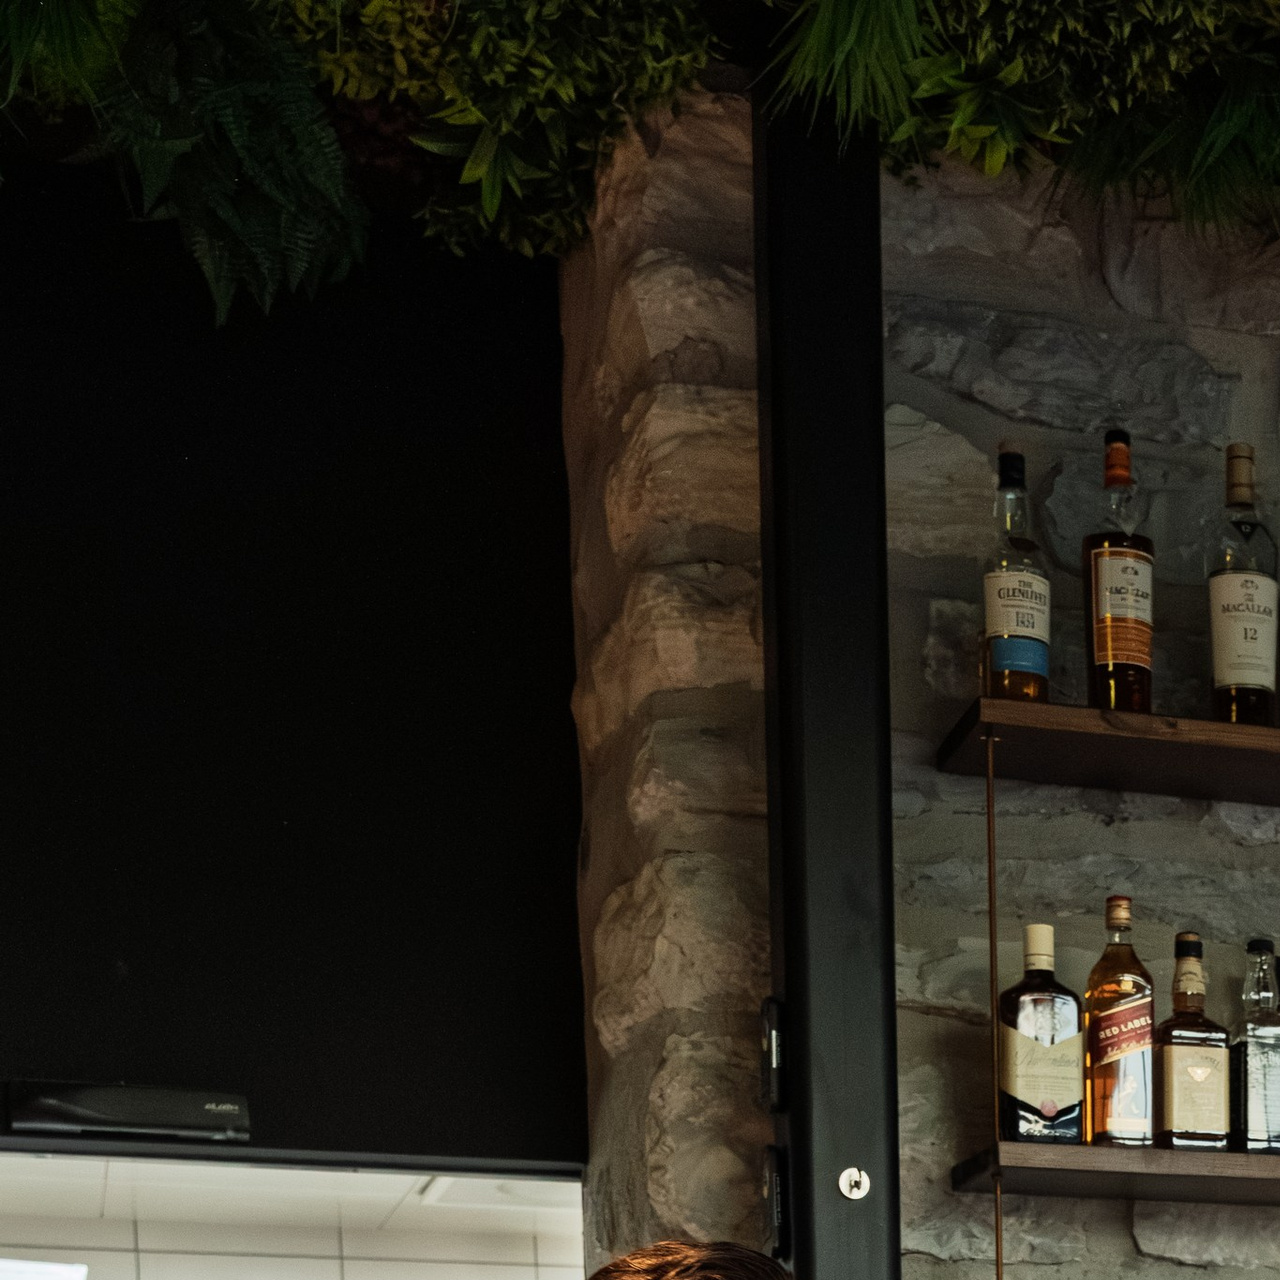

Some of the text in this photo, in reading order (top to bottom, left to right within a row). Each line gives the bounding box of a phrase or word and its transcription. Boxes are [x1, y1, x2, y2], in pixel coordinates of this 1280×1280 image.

[1243, 627, 1258, 641] 12
[1098, 1016, 1152, 1040] RED LABEL
